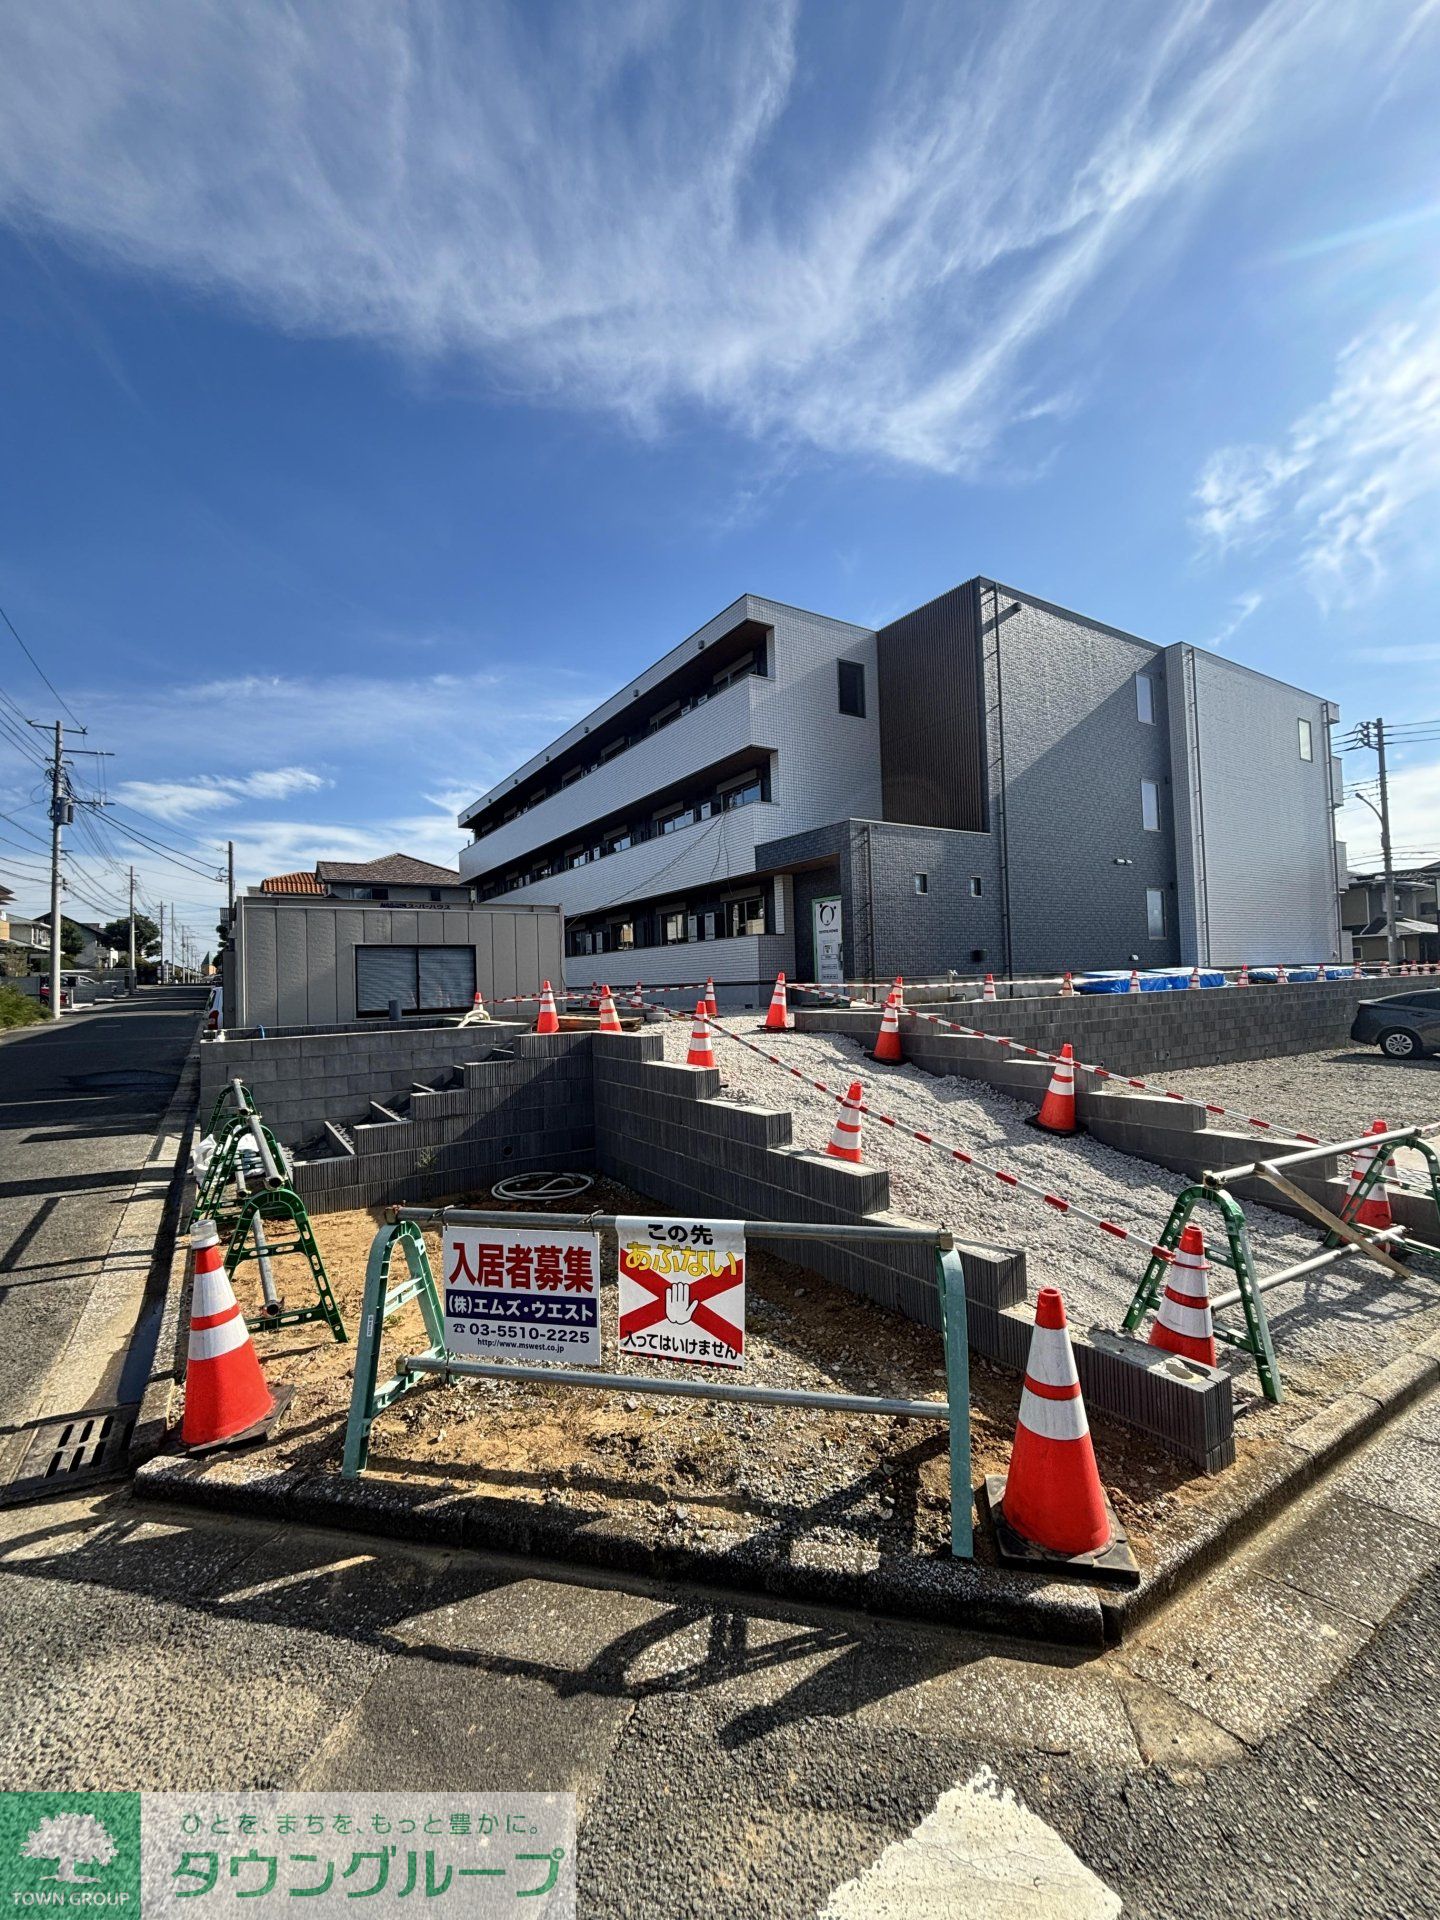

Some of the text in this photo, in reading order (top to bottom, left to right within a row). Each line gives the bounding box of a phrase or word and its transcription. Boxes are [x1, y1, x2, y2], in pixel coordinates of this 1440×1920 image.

[647, 1223, 714, 1246] この先
[448, 1242, 594, 1293] 入居者募集
[625, 1241, 738, 1278] あぶない
[448, 1294, 594, 1322] (株)エムズ・ウエスト
[469, 1322, 590, 1344] 03-5510-2225
[477, 1337, 565, 1353] http://www.mswest.co.jp
[623, 1330, 739, 1360] 入ってはいけません
